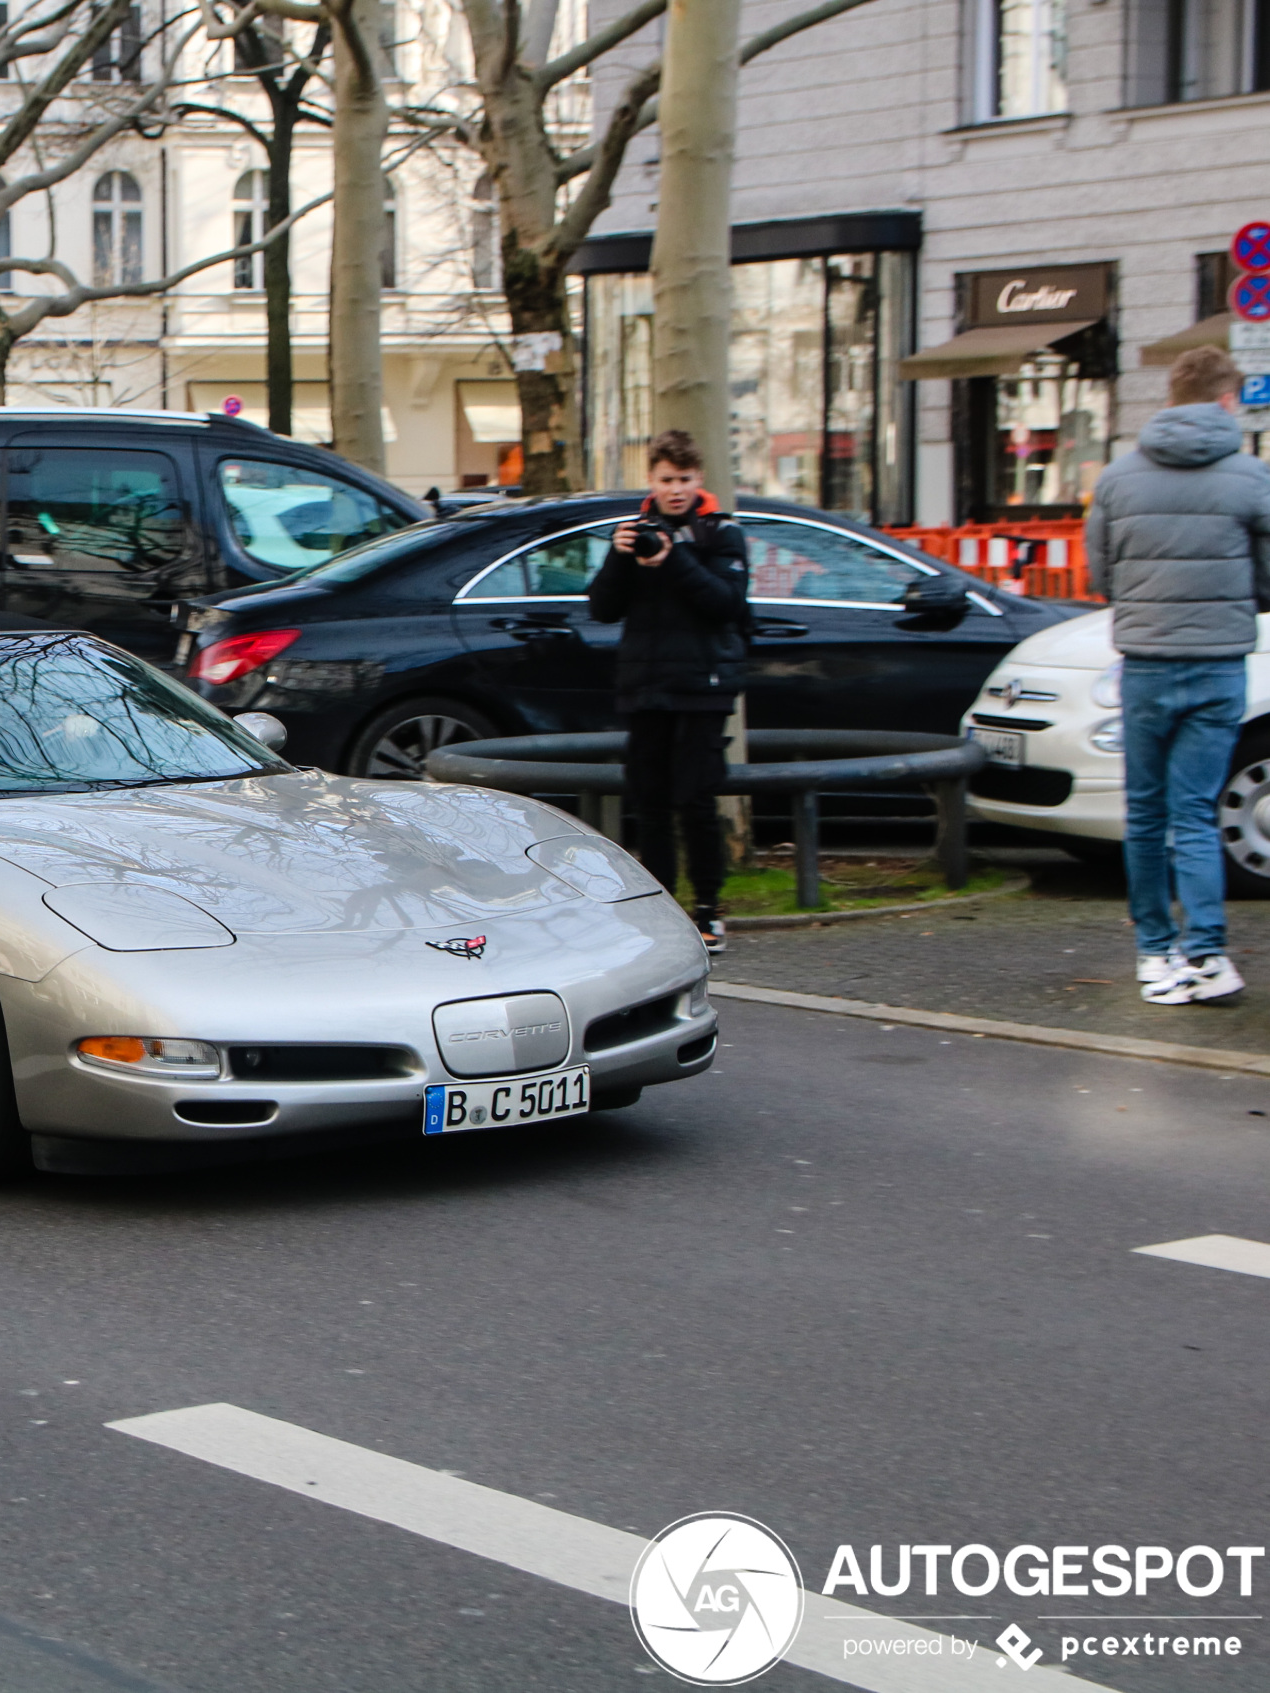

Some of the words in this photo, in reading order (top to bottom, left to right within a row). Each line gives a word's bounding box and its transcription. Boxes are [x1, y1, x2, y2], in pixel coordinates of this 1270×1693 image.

[996, 279, 1077, 313] Cartier
[448, 1022, 562, 1043] CORVETTE
[446, 1090, 467, 1127] B
[491, 1087, 511, 1121] C
[519, 1073, 587, 1118] 5011
[430, 1114, 439, 1125] D
